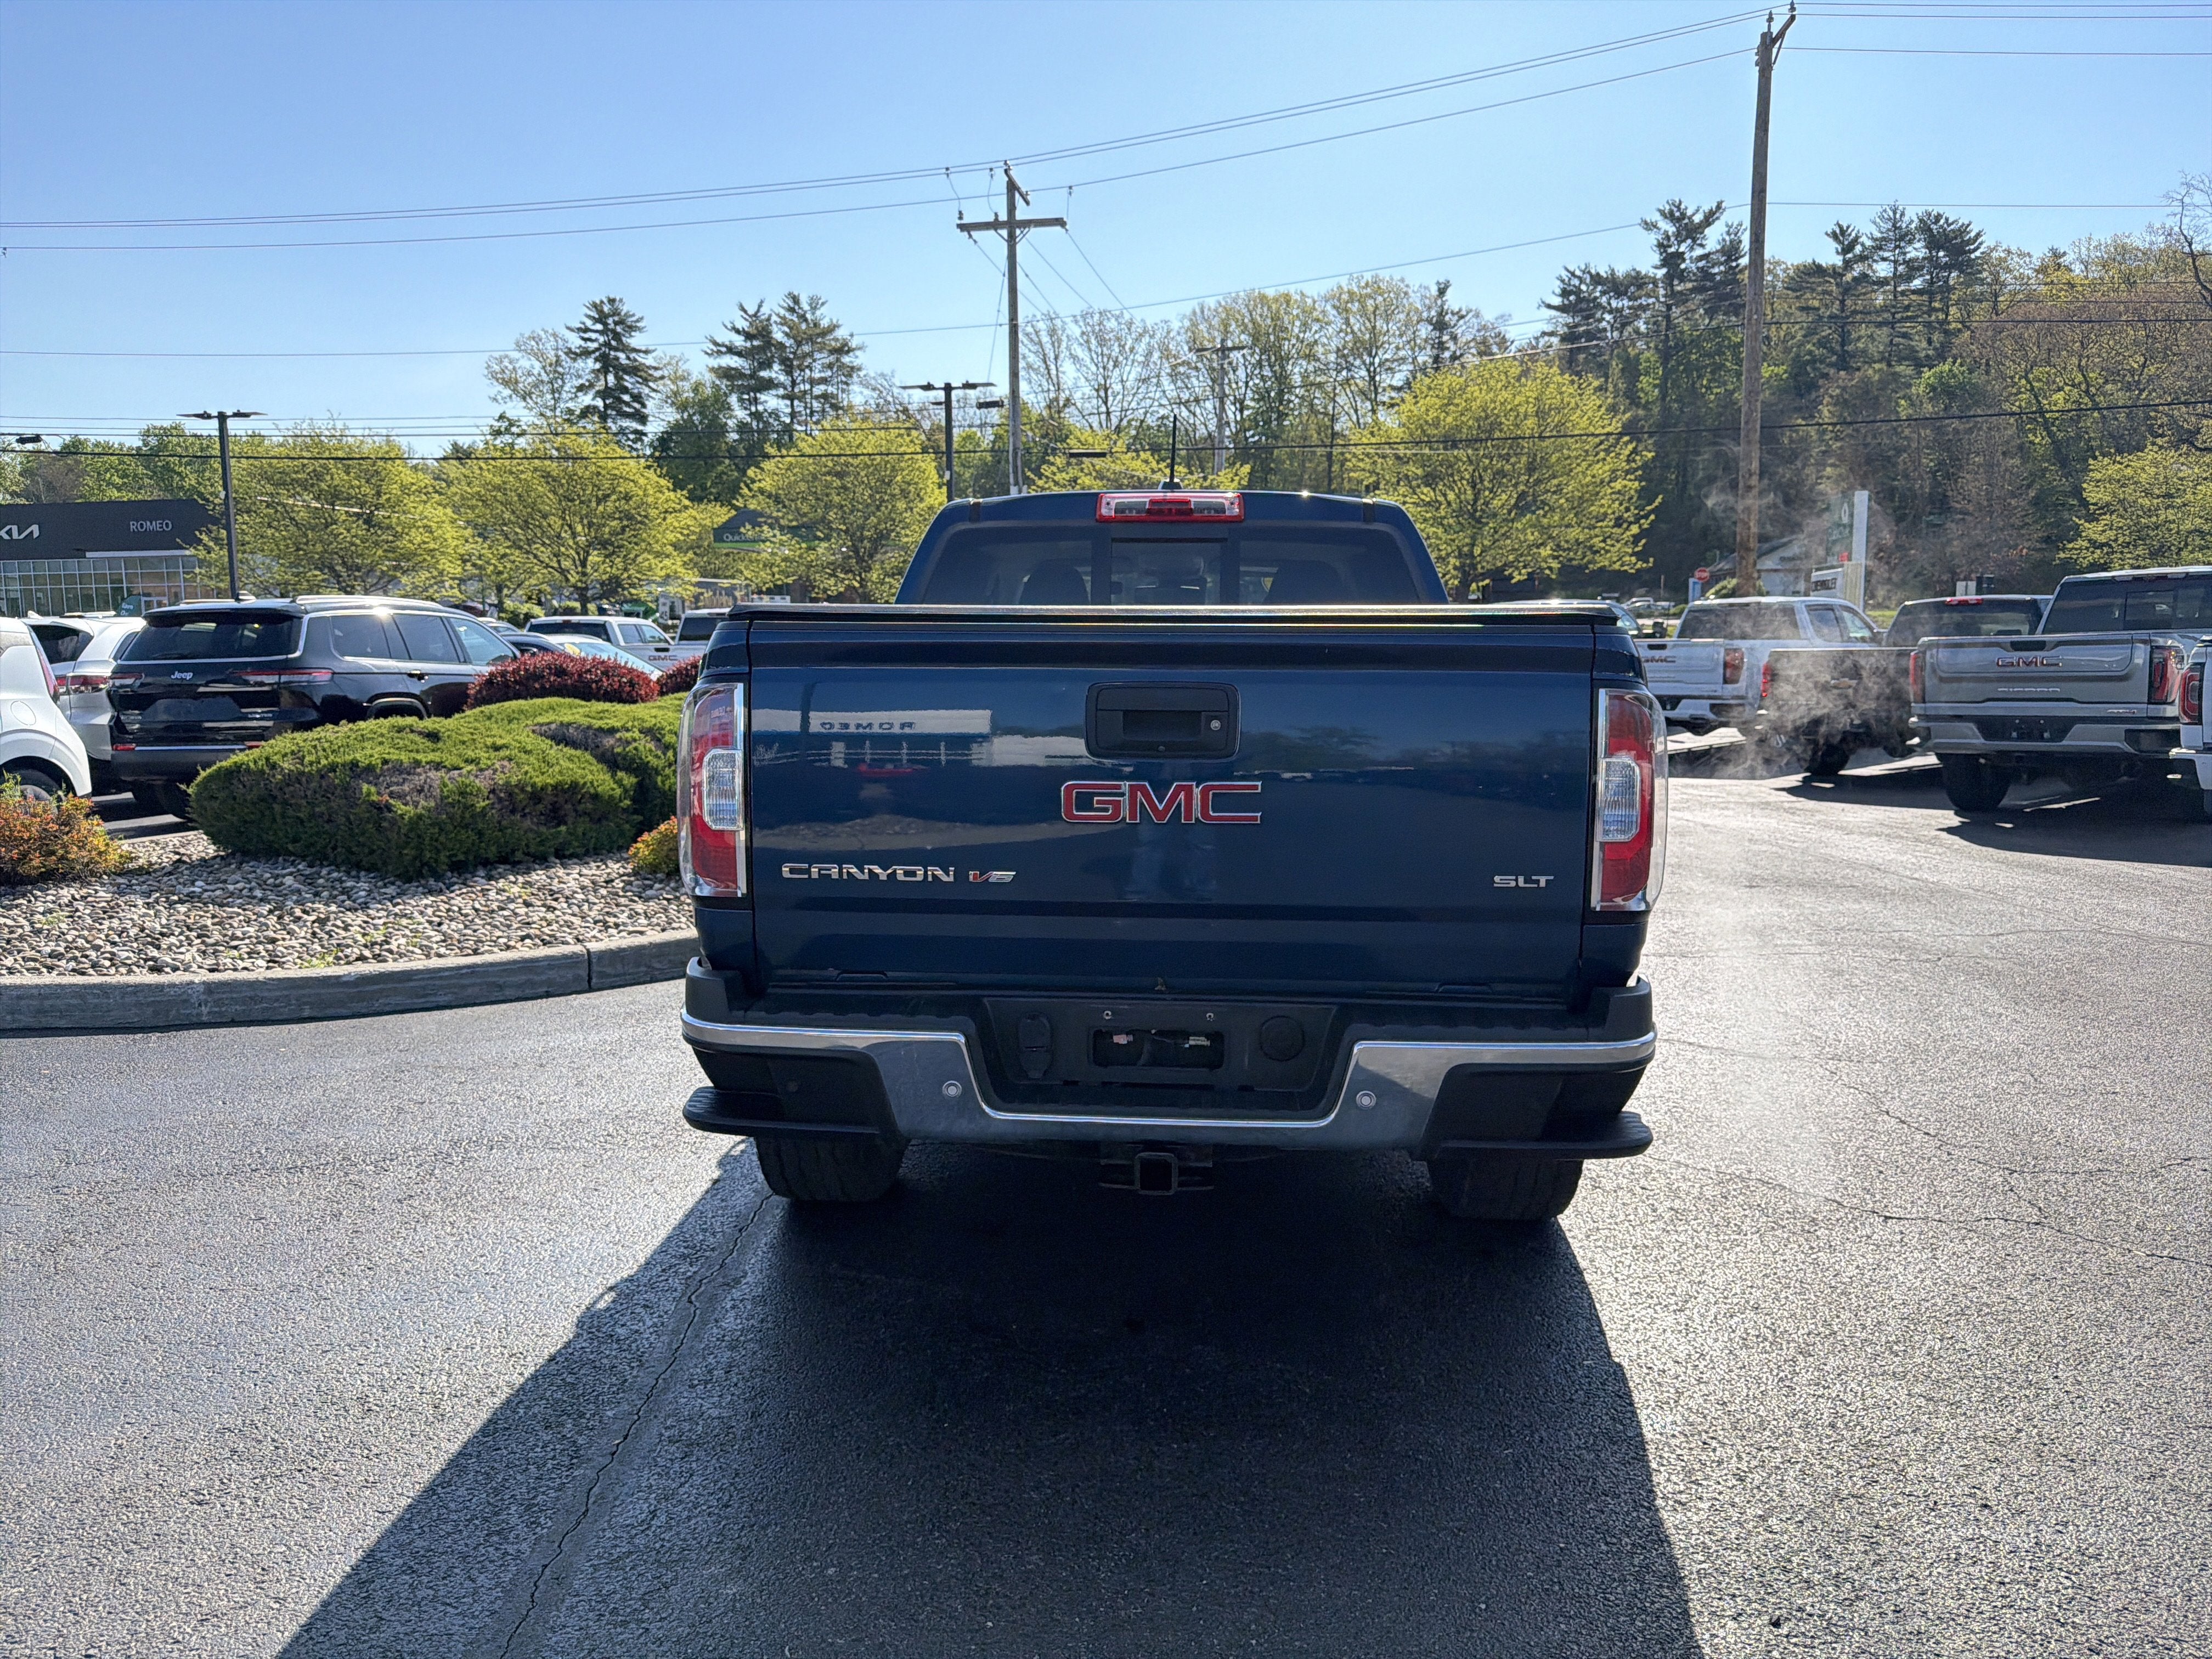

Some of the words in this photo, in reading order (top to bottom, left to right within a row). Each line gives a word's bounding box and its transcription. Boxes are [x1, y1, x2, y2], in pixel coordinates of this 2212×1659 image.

[129, 520, 173, 532] ROMEO
[1996, 655, 2063, 668] GMC
[171, 670, 194, 680] Jeep
[1061, 780, 1262, 823] GMC
[781, 863, 955, 883] CANYON
[969, 871, 1017, 883] V6
[1493, 875, 1554, 888] SLT
